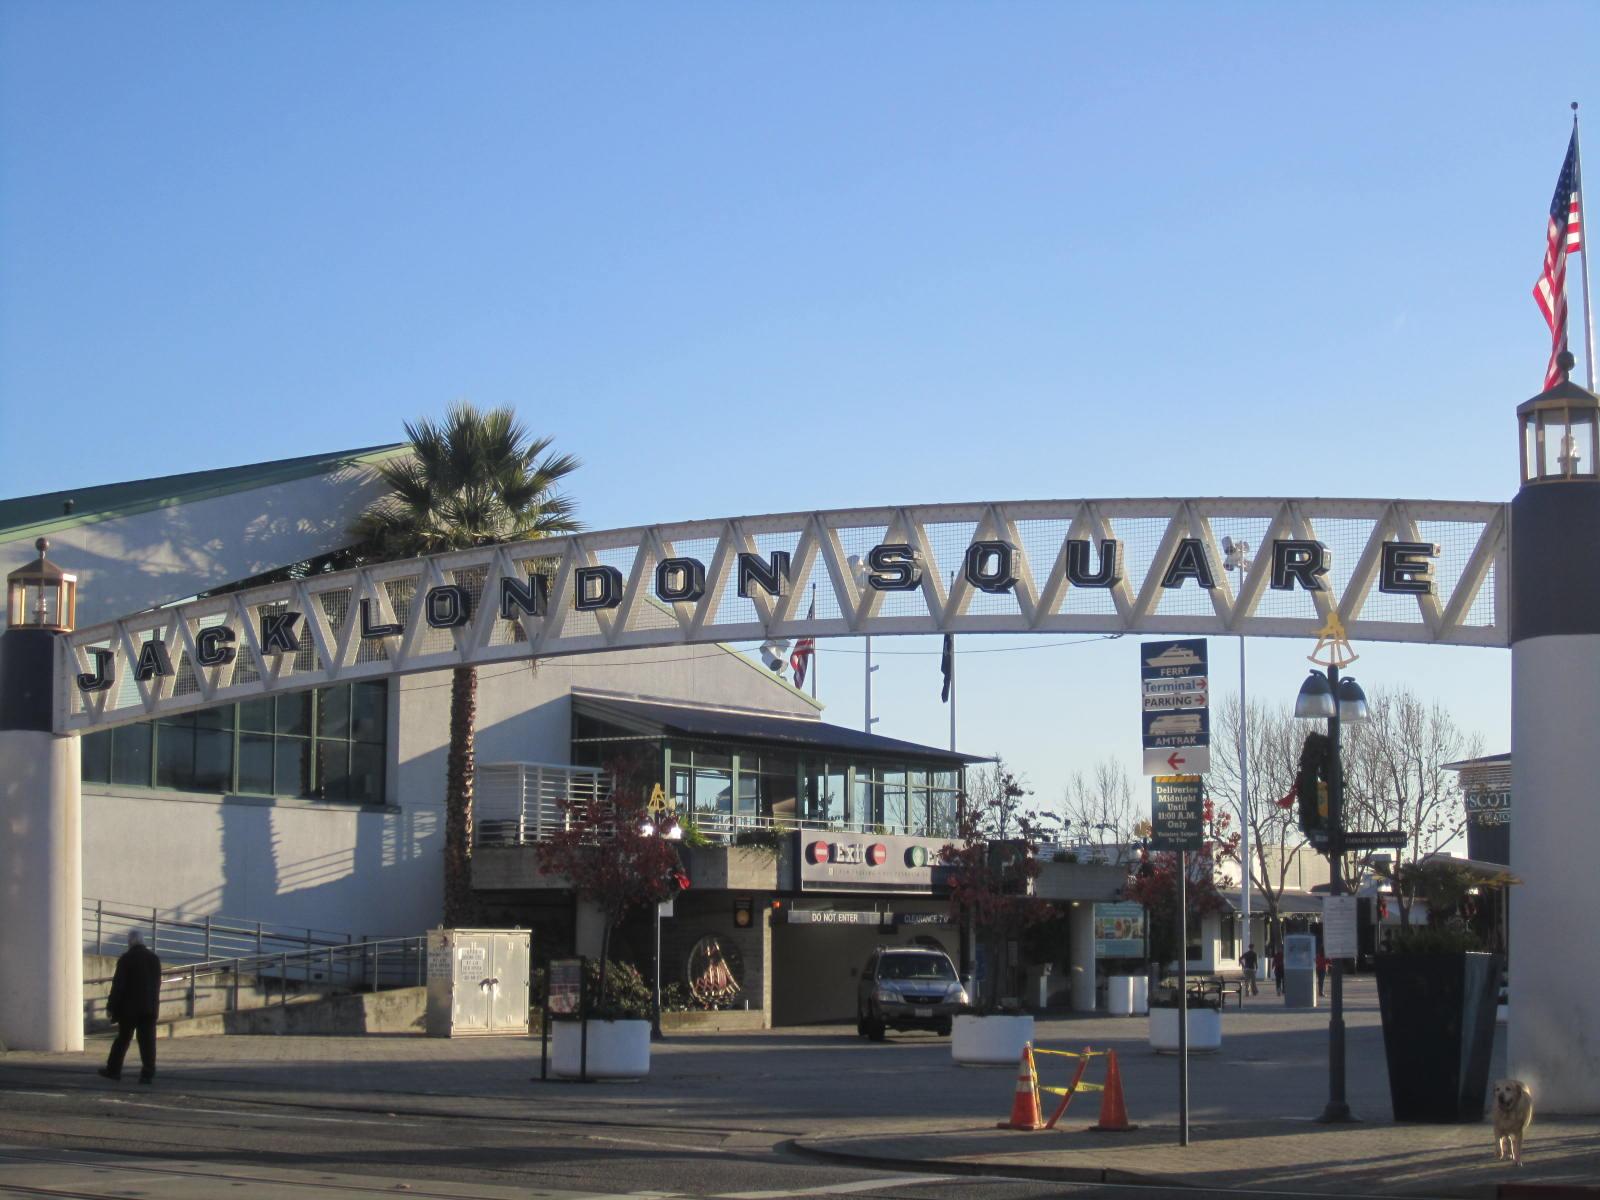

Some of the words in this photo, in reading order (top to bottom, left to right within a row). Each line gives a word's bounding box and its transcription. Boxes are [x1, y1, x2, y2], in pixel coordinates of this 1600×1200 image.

[77, 611, 302, 693] JACK
[360, 551, 791, 640] LONDON
[868, 538, 1442, 595] SQUARE
[1160, 666, 1191, 677] FERRY
[1144, 680, 1196, 693] Terminal
[1144, 696, 1193, 707] PARKING
[1155, 735, 1197, 746] AMTRAK
[1156, 786, 1198, 794] Deliveries
[1158, 794, 1197, 803] Midnight
[1167, 803, 1187, 811] Until
[1167, 820, 1188, 829] Only
[836, 843, 865, 863] Exit
[811, 912, 822, 922] DO
[823, 912, 837, 922] NOT
[838, 912, 858, 922] ENTER
